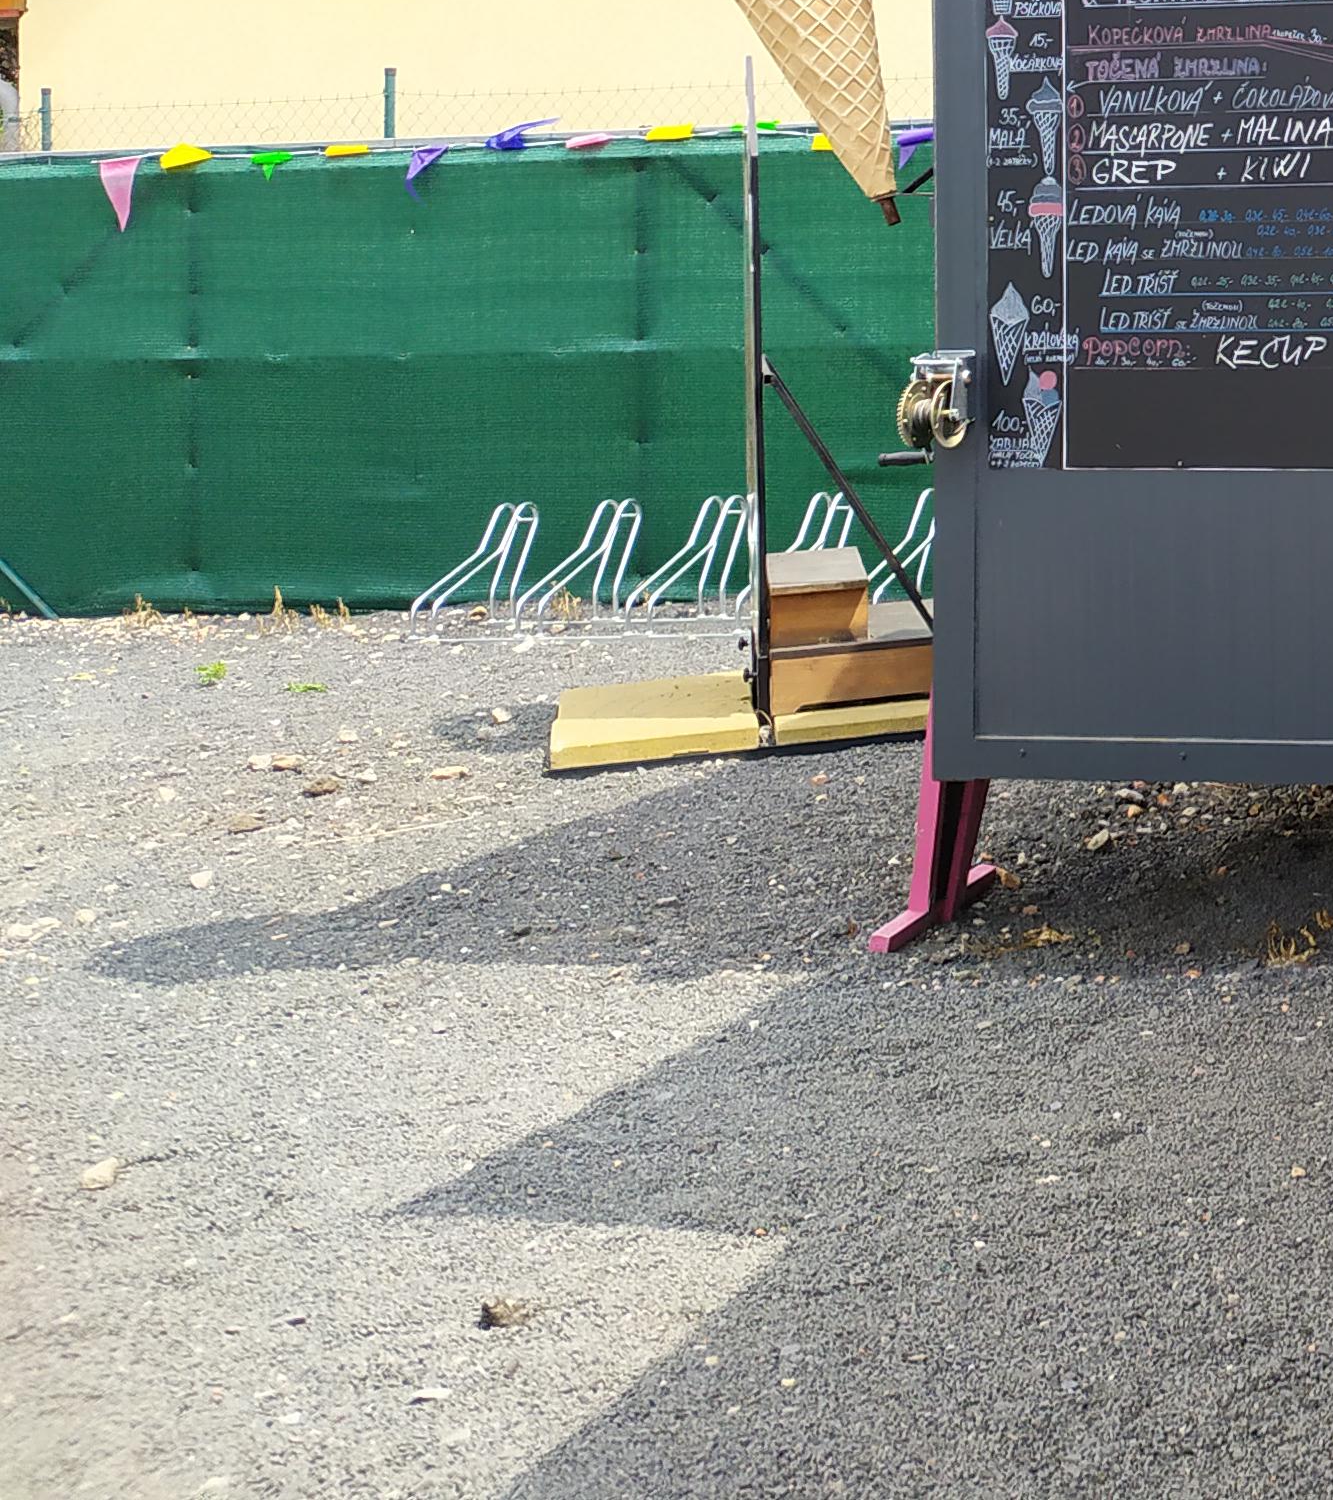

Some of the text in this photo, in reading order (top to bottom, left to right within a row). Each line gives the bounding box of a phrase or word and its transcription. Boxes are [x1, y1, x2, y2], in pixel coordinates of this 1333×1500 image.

[1092, 158, 1177, 185] GREP
[1241, 151, 1311, 182] KIWI
[1068, 194, 1182, 230] LEDOVÁ KÁVA
[1066, 239, 1099, 264] LED
[1101, 268, 1132, 295] LED
[1100, 307, 1128, 330] LED
